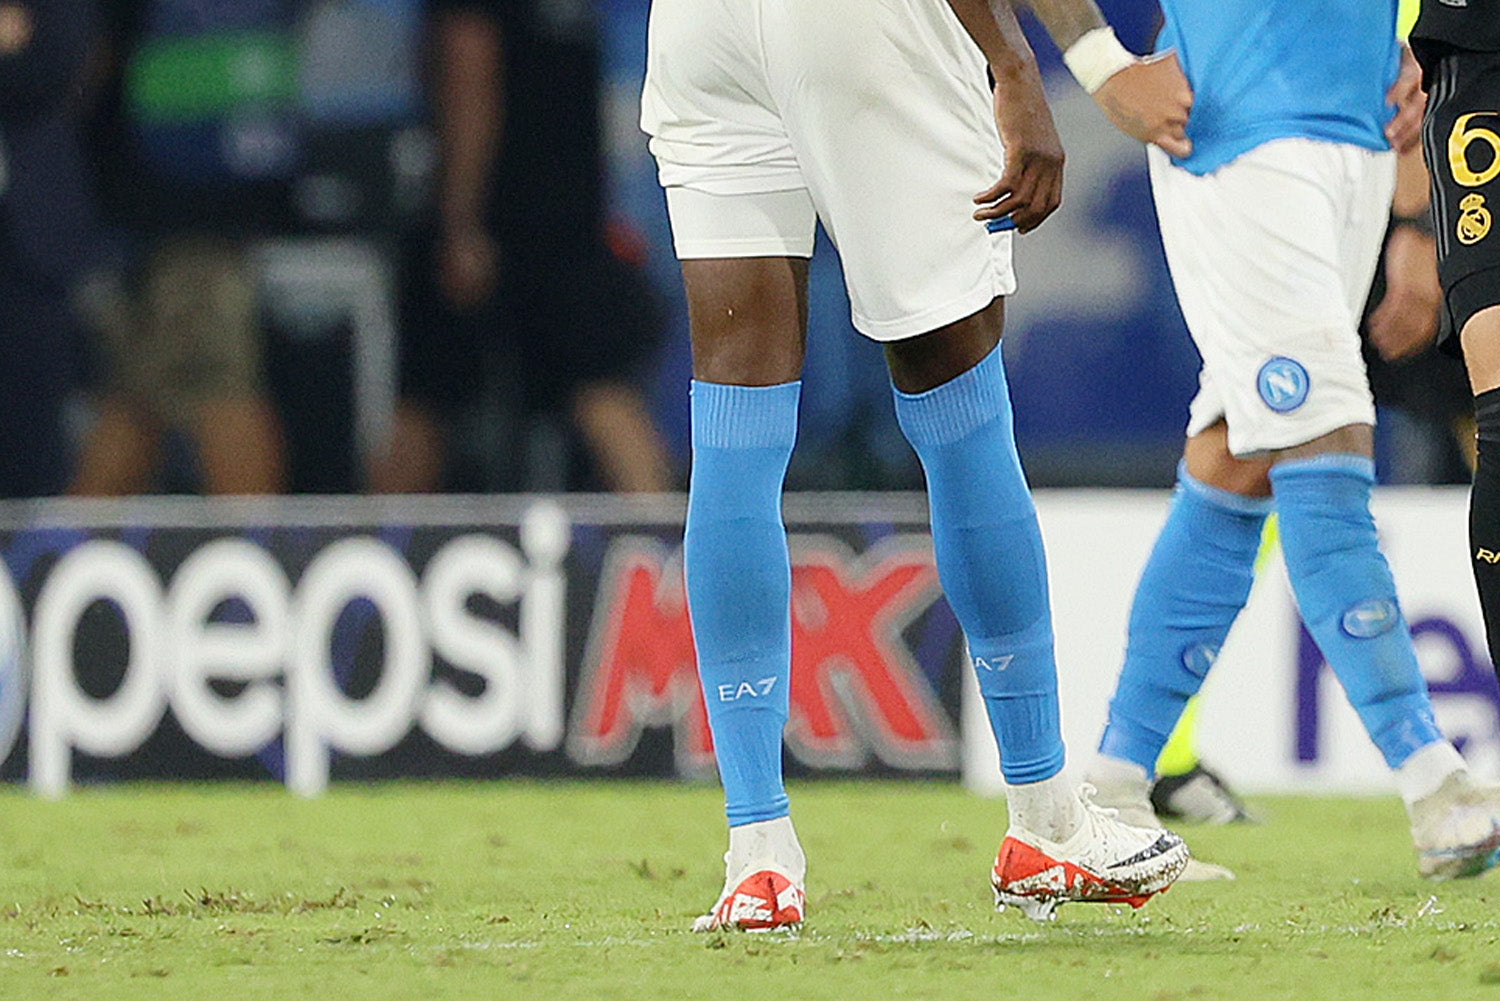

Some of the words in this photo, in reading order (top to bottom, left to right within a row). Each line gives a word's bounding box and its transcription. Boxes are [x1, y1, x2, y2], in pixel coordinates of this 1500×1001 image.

[28, 498, 568, 798] pepsi
[974, 653, 1015, 671] A7
[717, 676, 778, 703] EA7
